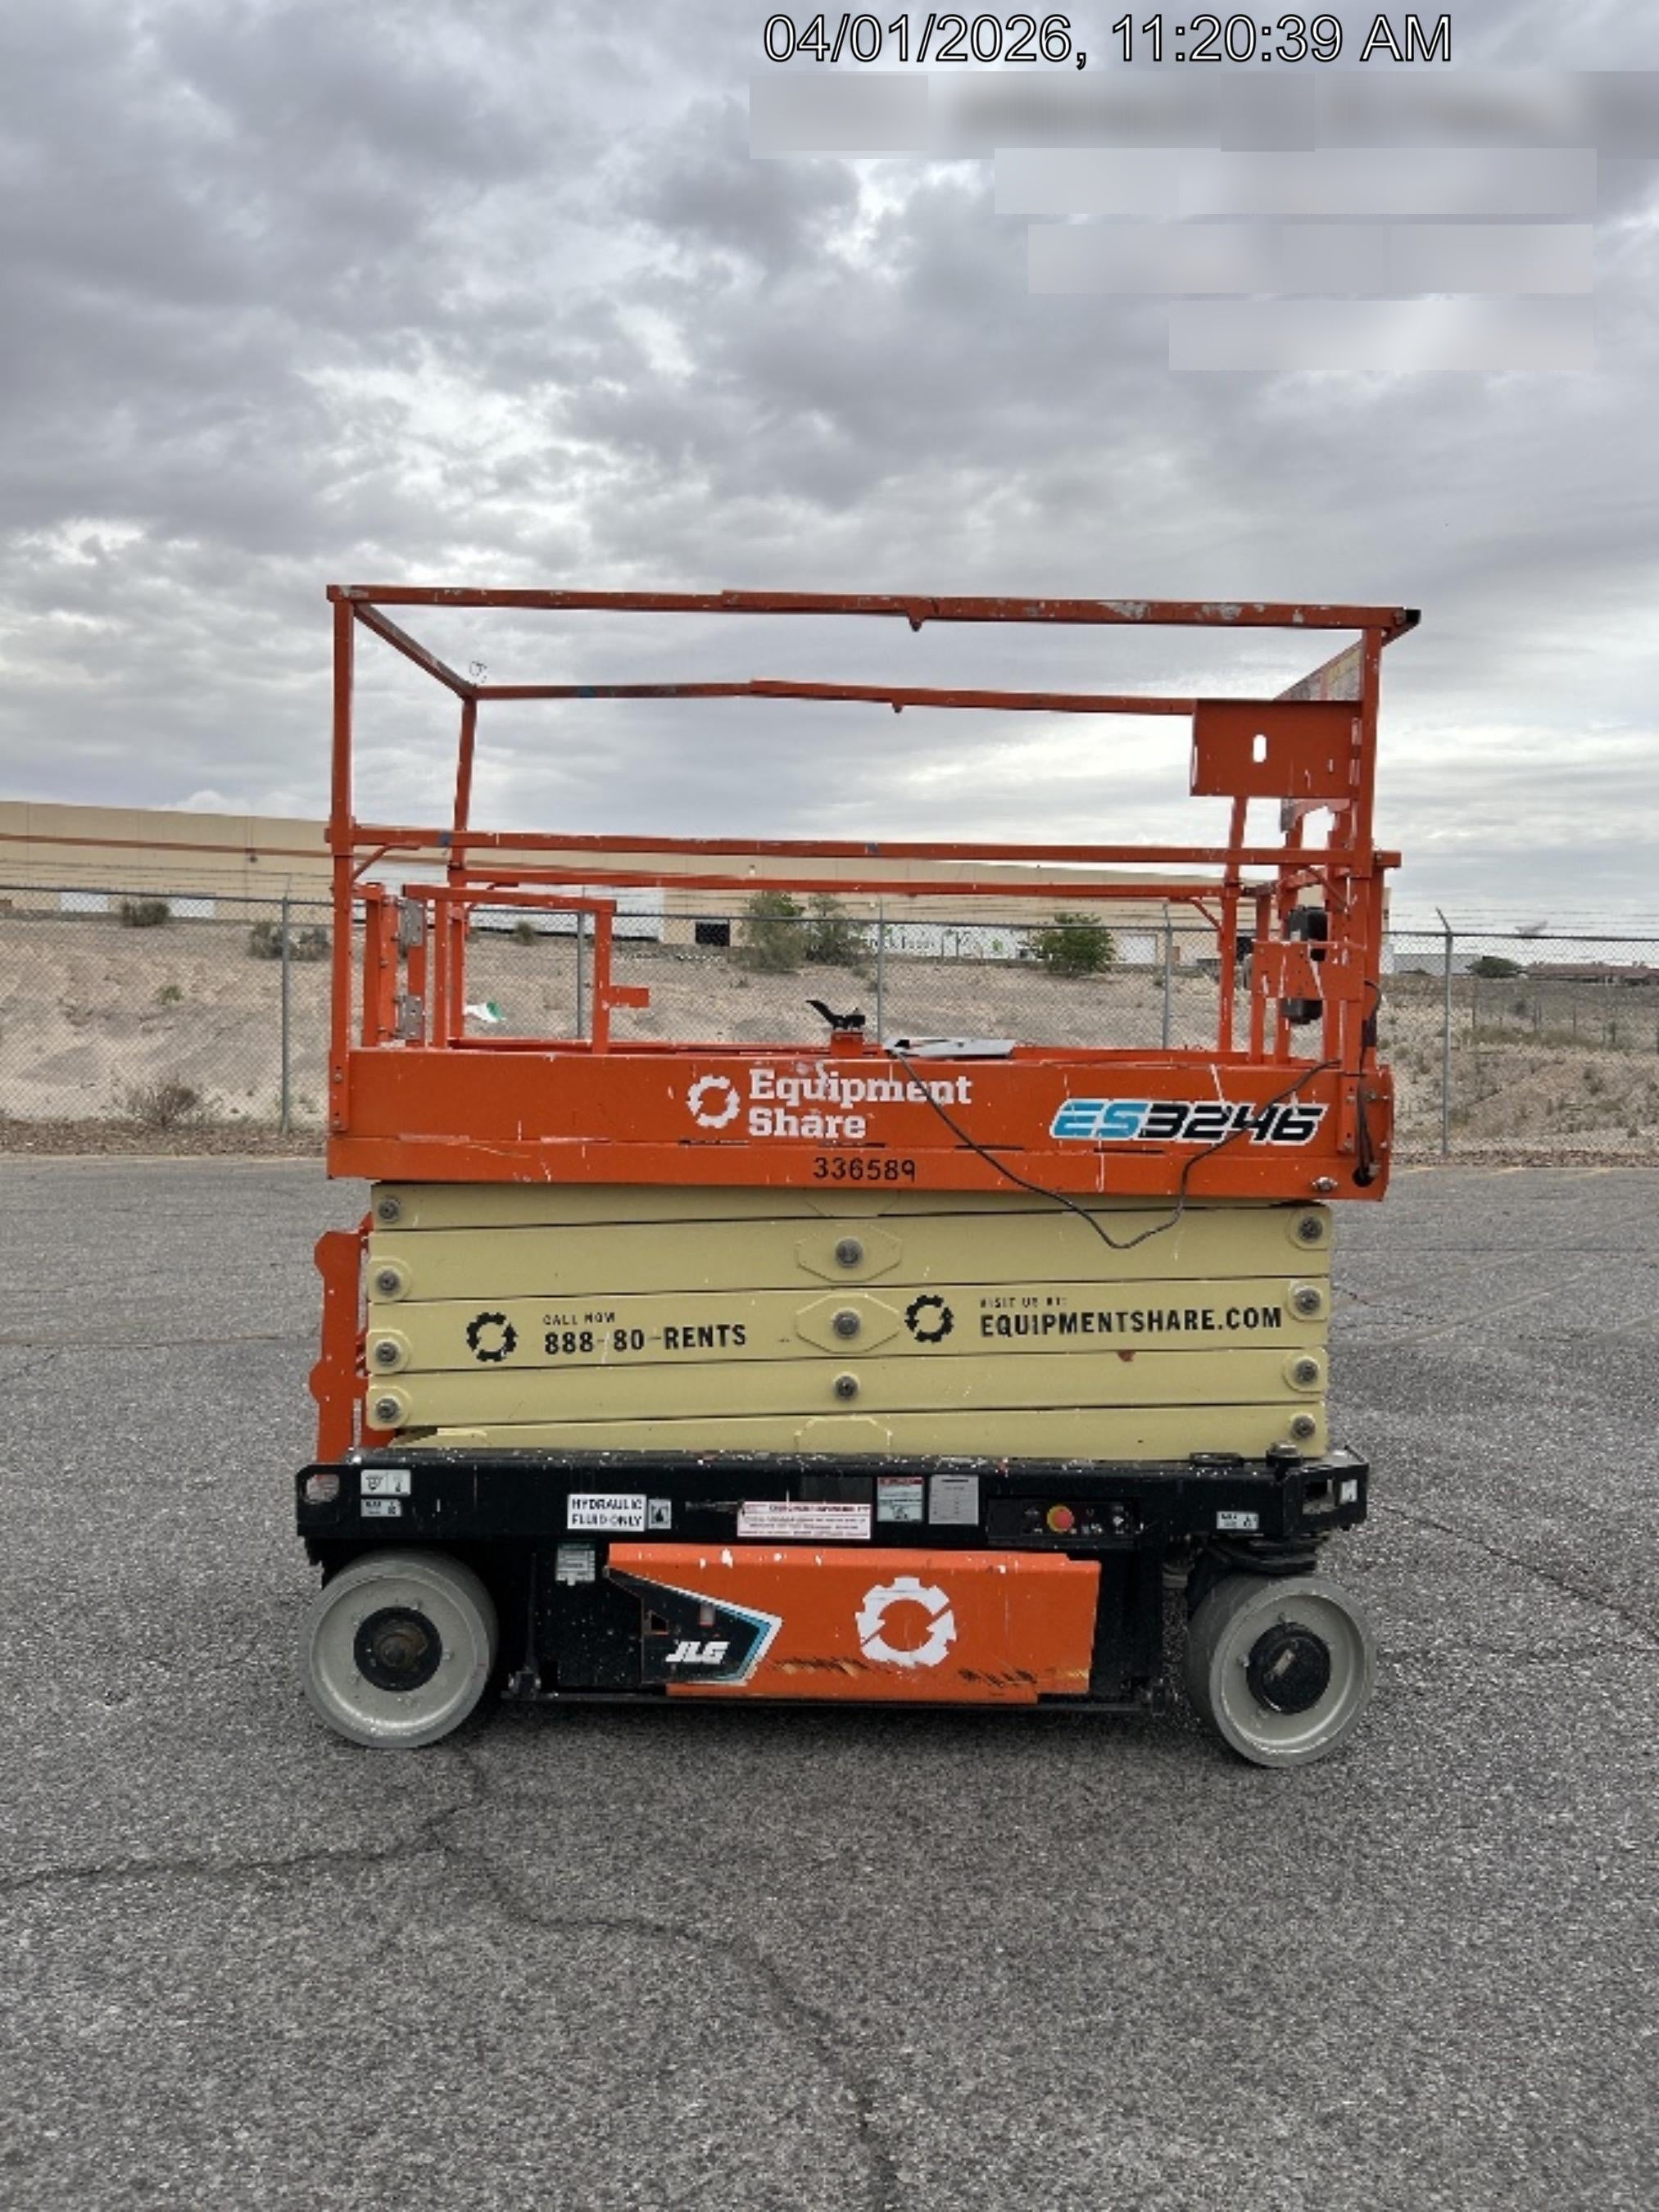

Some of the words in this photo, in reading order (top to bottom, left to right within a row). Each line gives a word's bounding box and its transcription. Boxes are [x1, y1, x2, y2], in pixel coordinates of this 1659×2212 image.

[749, 1067, 973, 1108] Equipment
[748, 1106, 867, 1139] Share
[1049, 1098, 1329, 1145] ES3246
[813, 1157, 916, 1182] 336589
[543, 1314, 578, 1326] CALL
[584, 1312, 615, 1323] NOW
[980, 1307, 1282, 1338] EQUIPMENTSHARE.COM
[572, 1498, 642, 1510] HYDRAULIC
[665, 1641, 731, 1665] JLG
